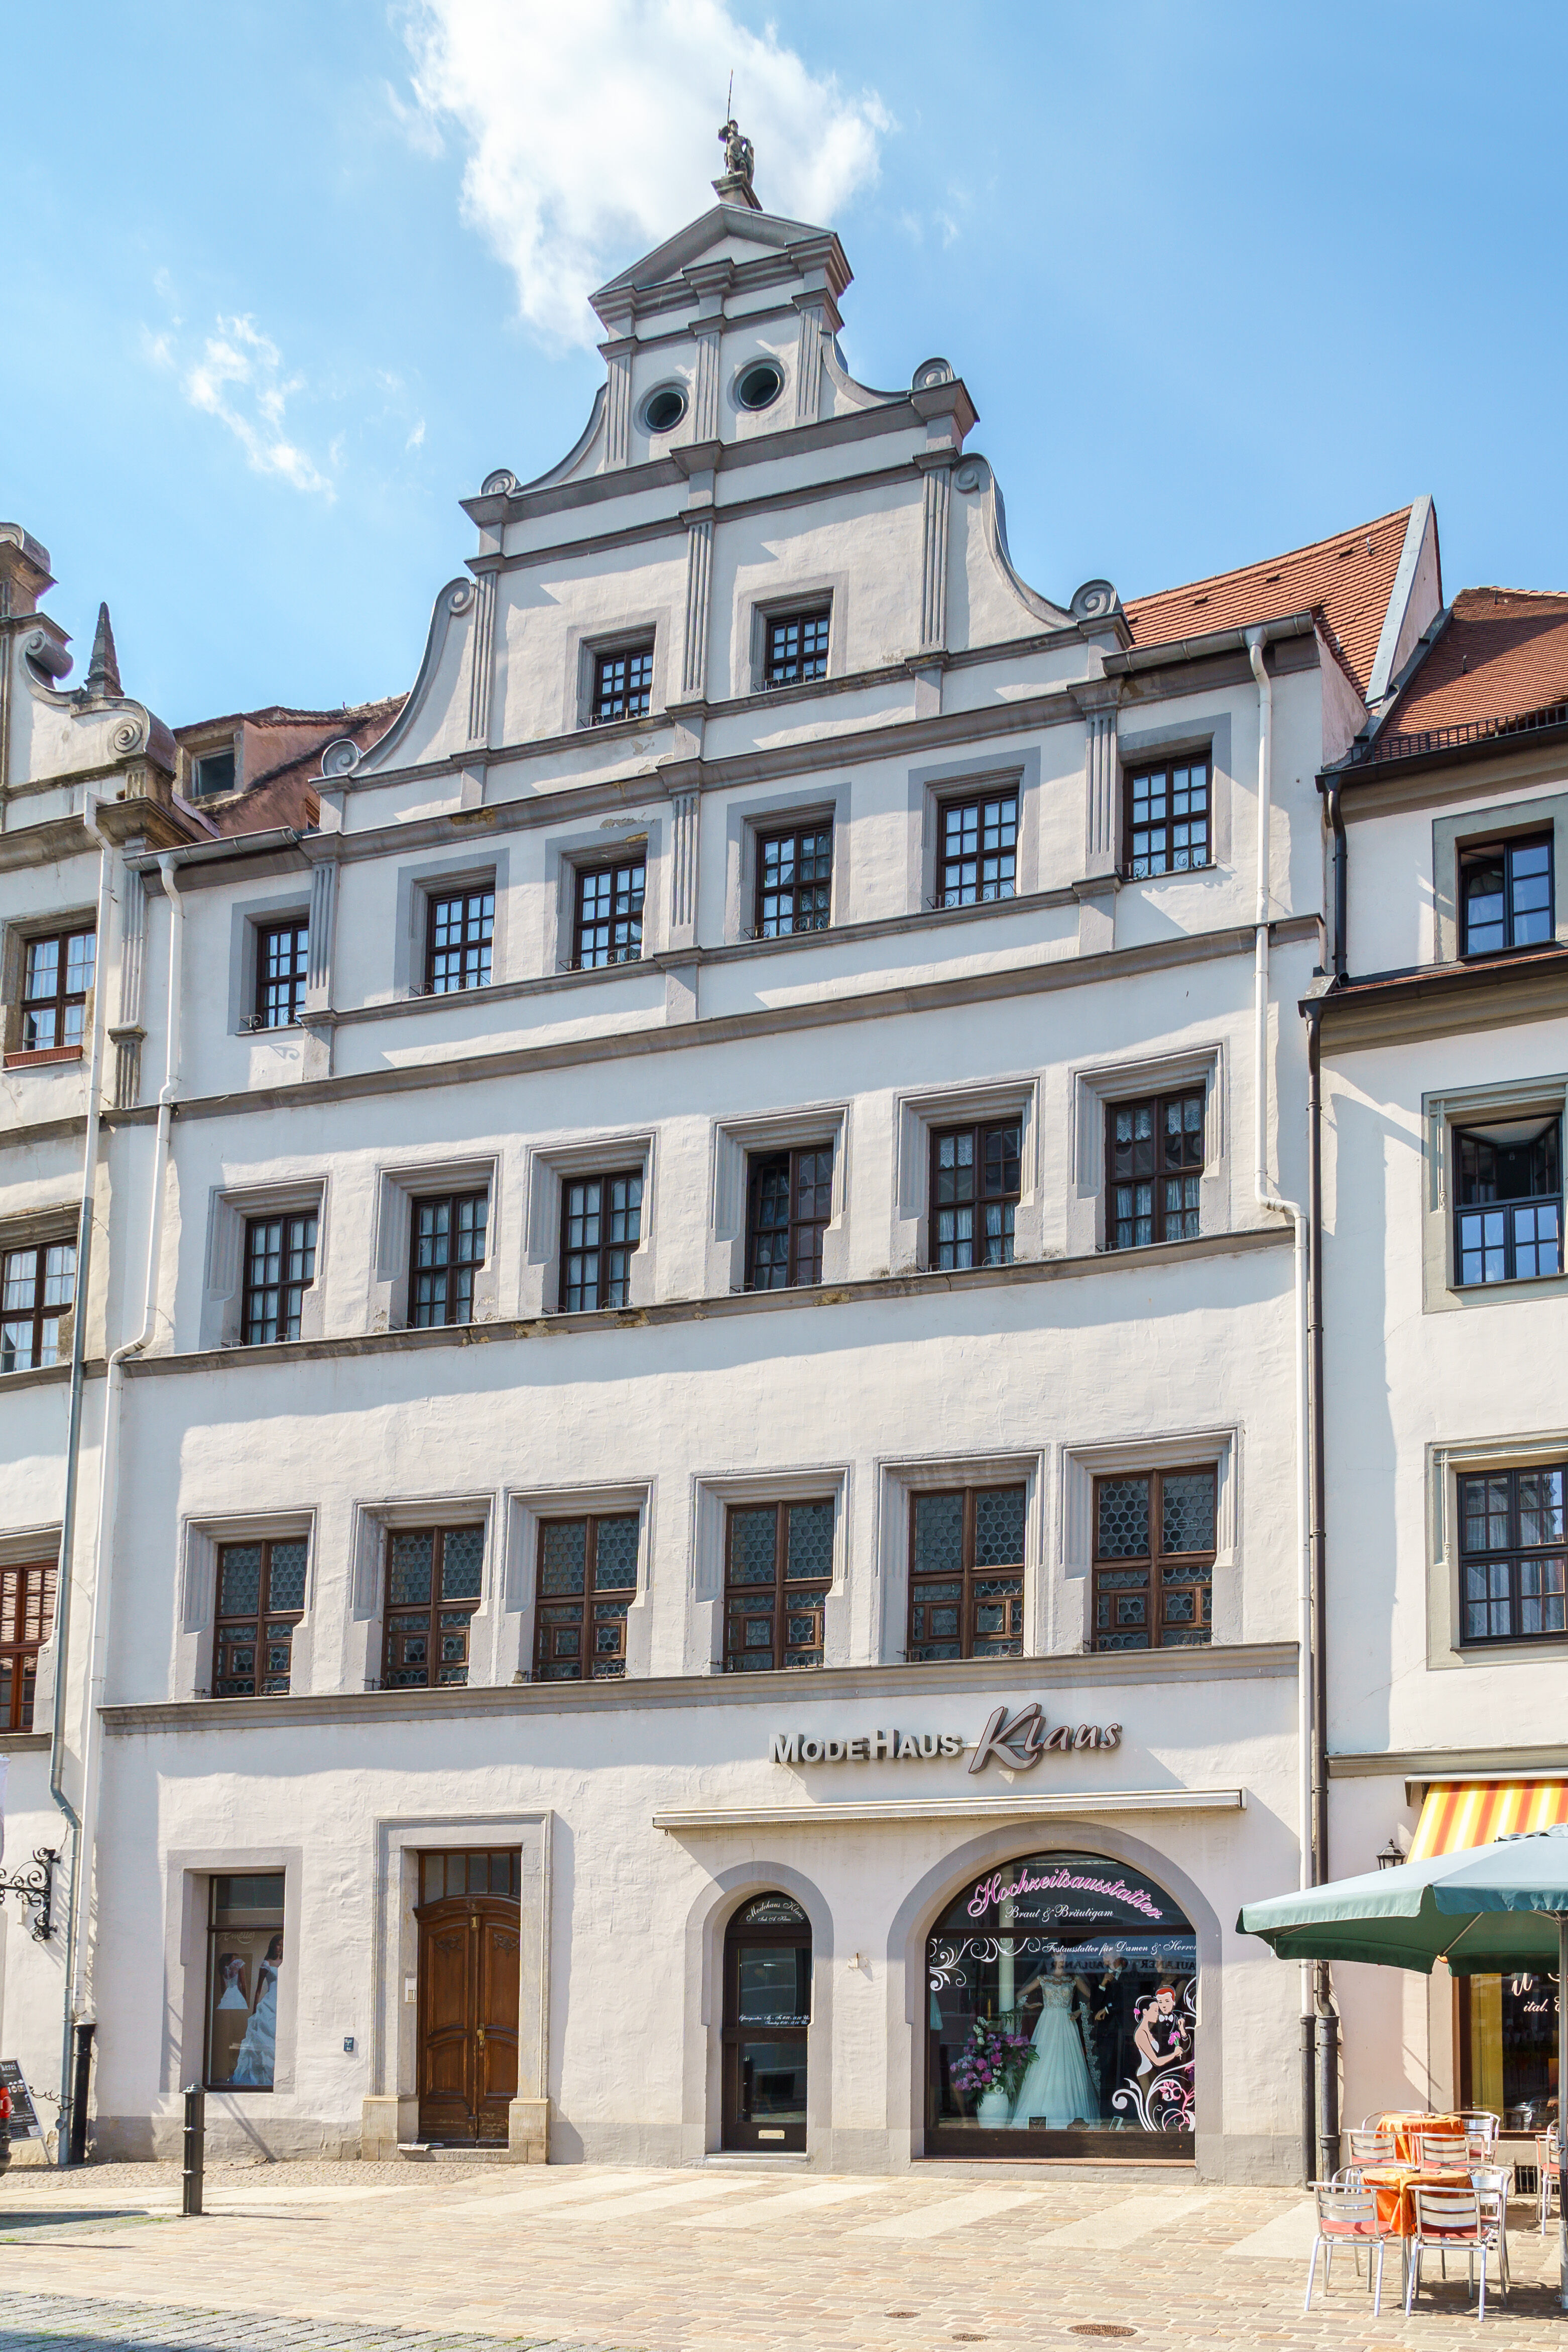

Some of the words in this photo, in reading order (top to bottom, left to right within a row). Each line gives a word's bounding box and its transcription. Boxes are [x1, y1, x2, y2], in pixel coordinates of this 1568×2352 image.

[969, 1702, 1123, 1775] Klaus
[967, 1868, 1163, 1919] Hochzeitsausstatter
[746, 1900, 781, 1922] Modehaus
[783, 1901, 805, 1920] Klaus
[1005, 1905, 1040, 1919] Braut
[1041, 1907, 1054, 1922] &
[1054, 1904, 1114, 1922] Bräutigam
[471, 1916, 477, 1928] 1
[1042, 1942, 1099, 1953] Festausstatter
[1099, 1943, 1113, 1956] für
[1115, 1941, 1148, 1952] Damen
[1150, 1942, 1161, 1955] &
[1523, 1998, 1548, 2012] ital.
